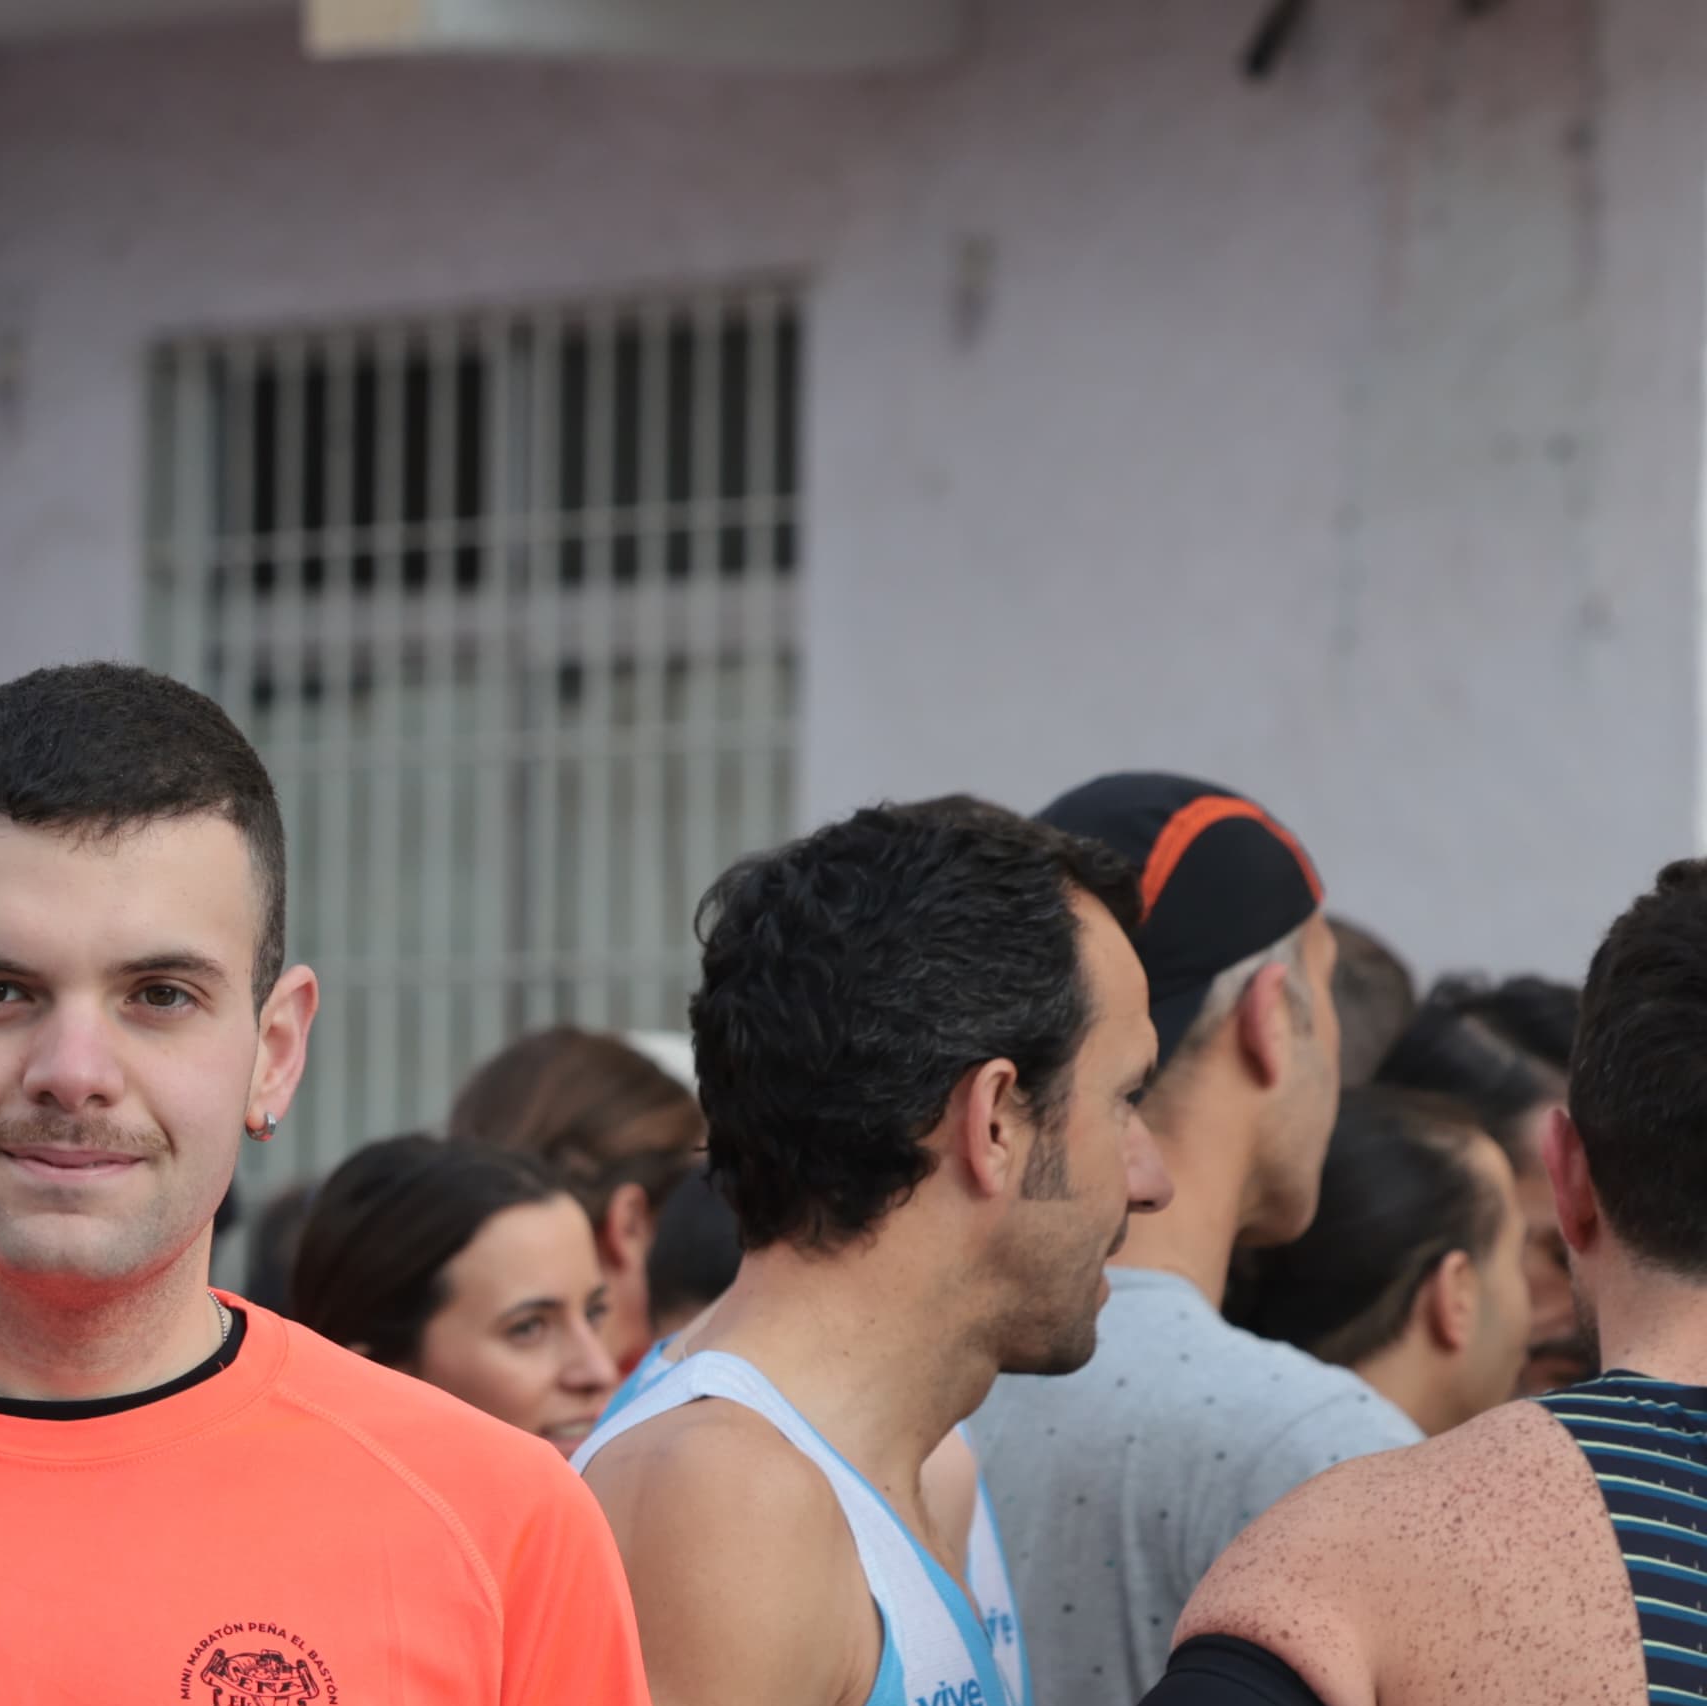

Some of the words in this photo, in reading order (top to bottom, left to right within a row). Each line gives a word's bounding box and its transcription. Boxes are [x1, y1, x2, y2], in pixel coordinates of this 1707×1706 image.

[180, 1667, 194, 1700] MINI
[187, 1623, 245, 1667] MARATÓN
[247, 1621, 288, 1640] PEÑA
[290, 1634, 306, 1652] EL
[306, 1649, 339, 1706] BASTÓN
